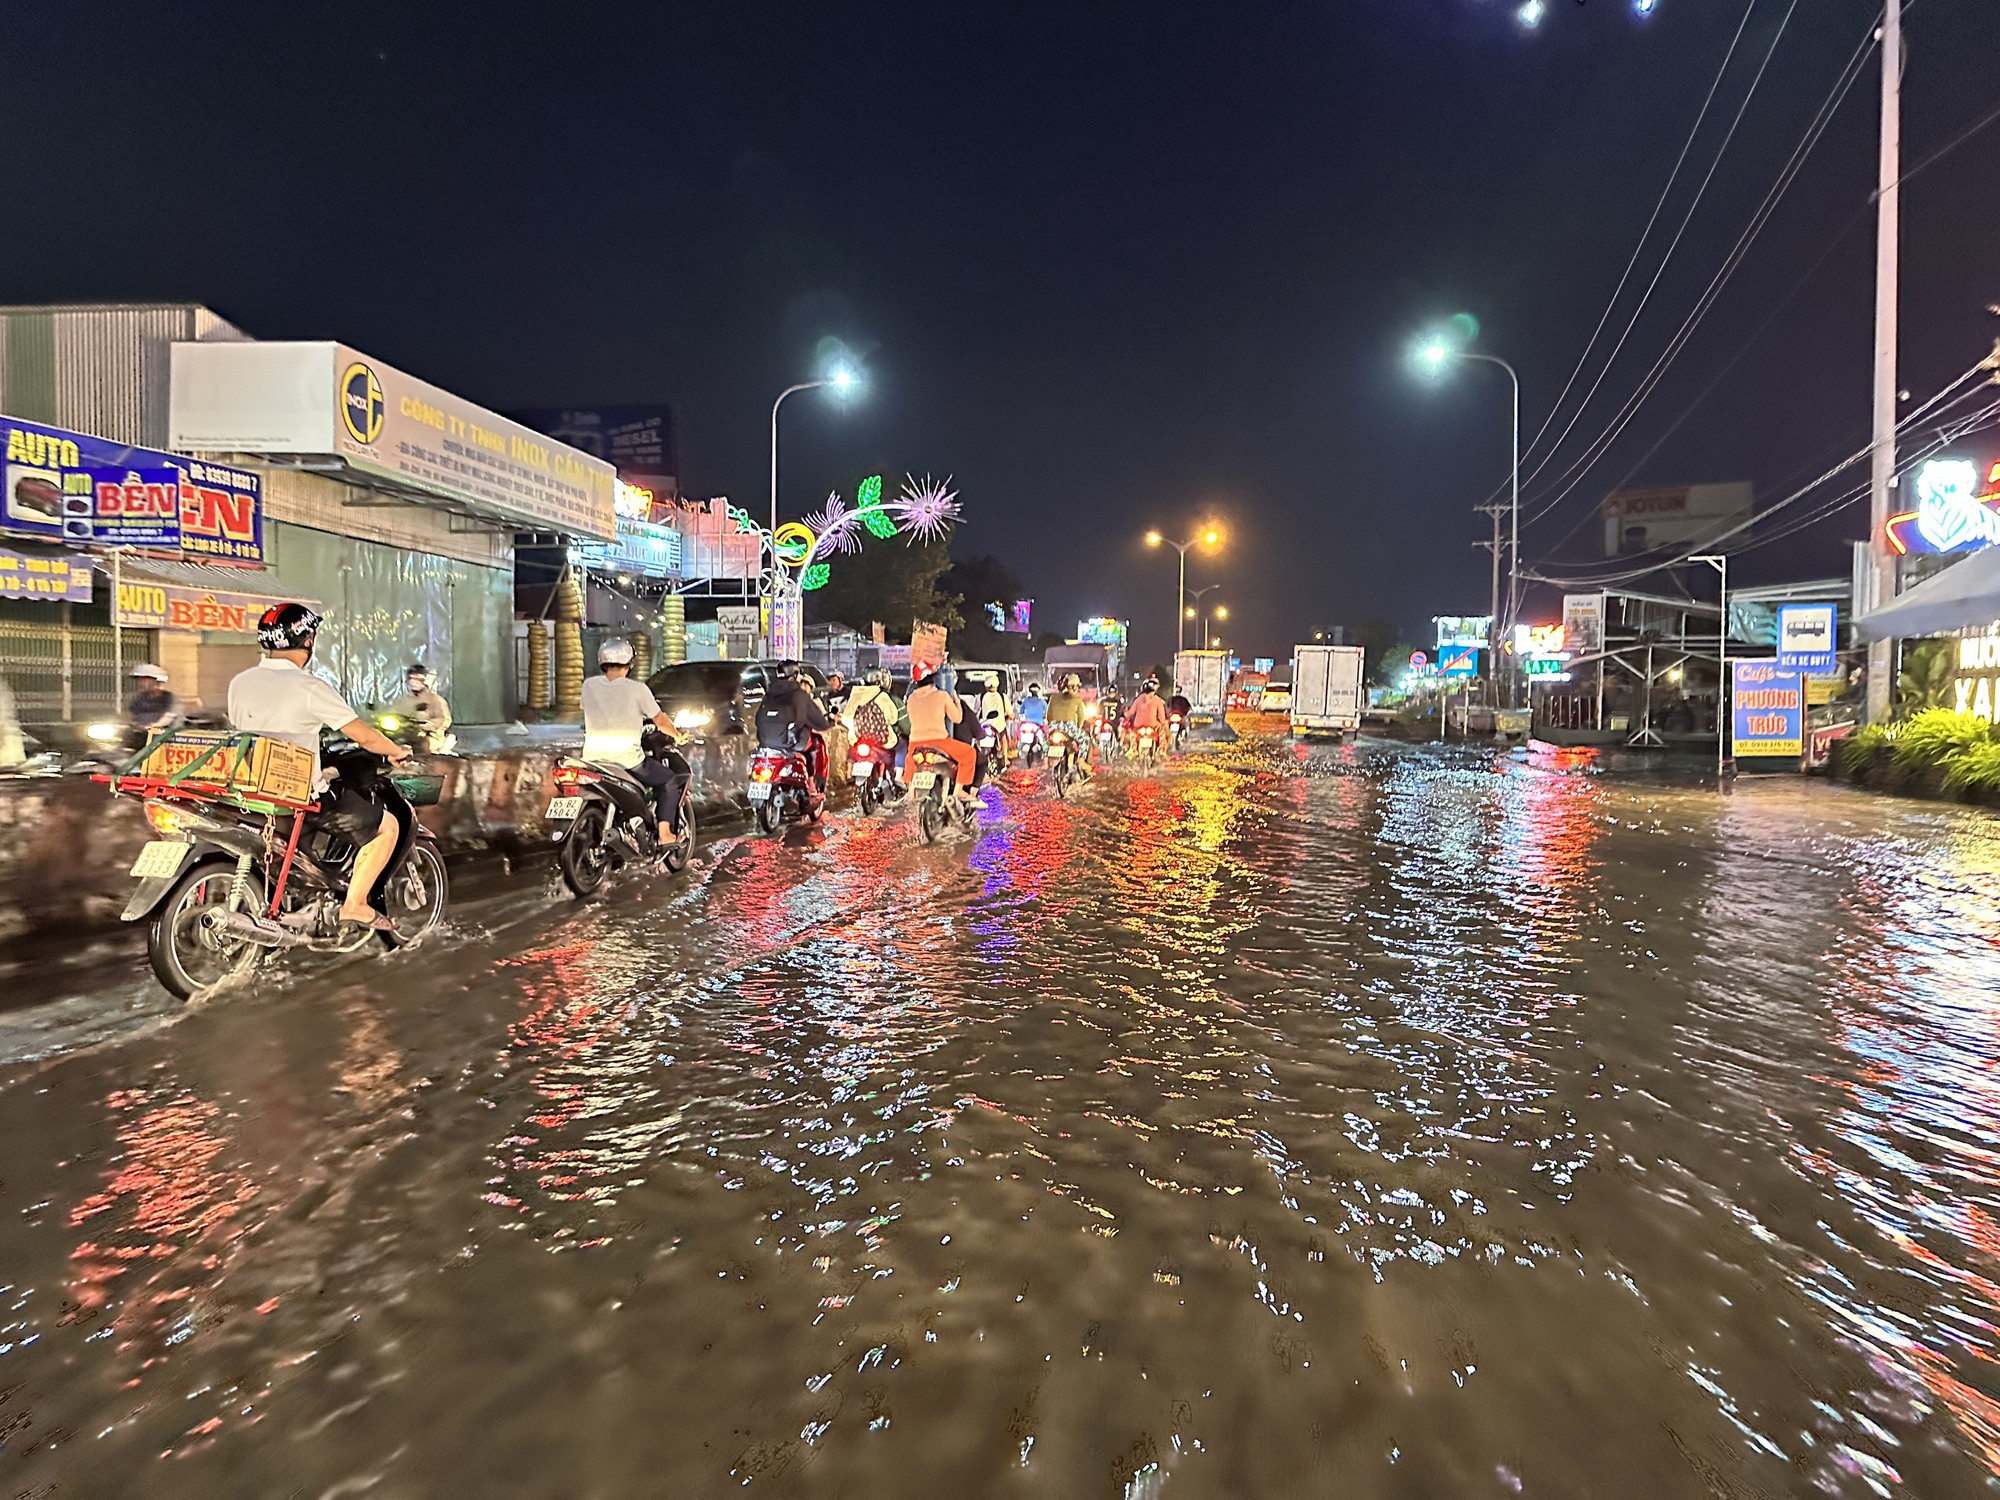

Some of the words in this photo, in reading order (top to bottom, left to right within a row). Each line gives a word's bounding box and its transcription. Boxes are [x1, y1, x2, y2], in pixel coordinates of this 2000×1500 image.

[400, 395, 446, 432] CÔNG
[450, 414, 467, 440] TY
[511, 435, 549, 473] INOX
[7, 428, 79, 469] AUTO
[119, 584, 166, 615] AUTO
[169, 593, 247, 632] BỀN
[1736, 688, 1799, 709] PHƯƠNG
[1104, 705, 1117, 720] 15
[1746, 711, 1787, 735] TRÚC
[138, 859, 173, 874] 2133
